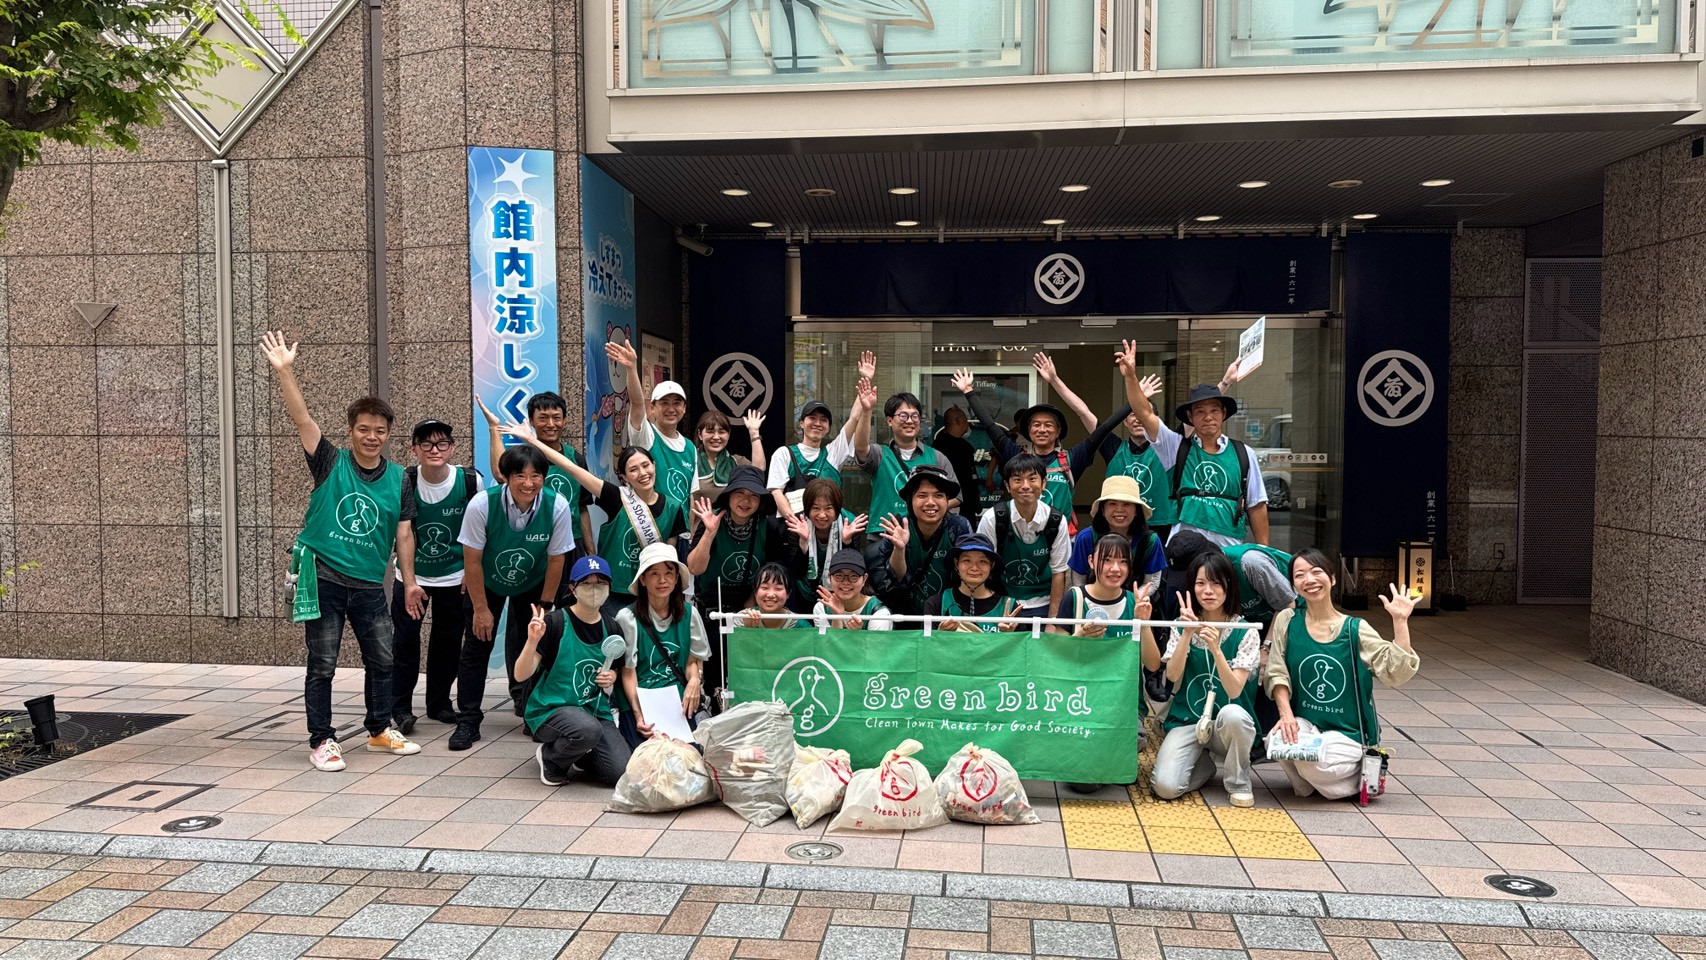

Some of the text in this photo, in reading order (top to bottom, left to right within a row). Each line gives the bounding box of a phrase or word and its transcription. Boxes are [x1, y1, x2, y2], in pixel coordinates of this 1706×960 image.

[490, 199, 537, 448] 館内涼しく
[976, 381, 997, 389] Tiffany
[442, 507, 464, 517] UACJ
[633, 504, 647, 525] SDGs
[328, 531, 374, 548] green bird
[525, 533, 550, 542] UACJ
[588, 558, 600, 569] LA
[863, 673, 1092, 716] green bird
[1302, 700, 1344, 714] green bird
[865, 717, 1095, 738] Clean Town Makes for Good Society.
[873, 803, 922, 818] green bird
[952, 797, 978, 815] green
